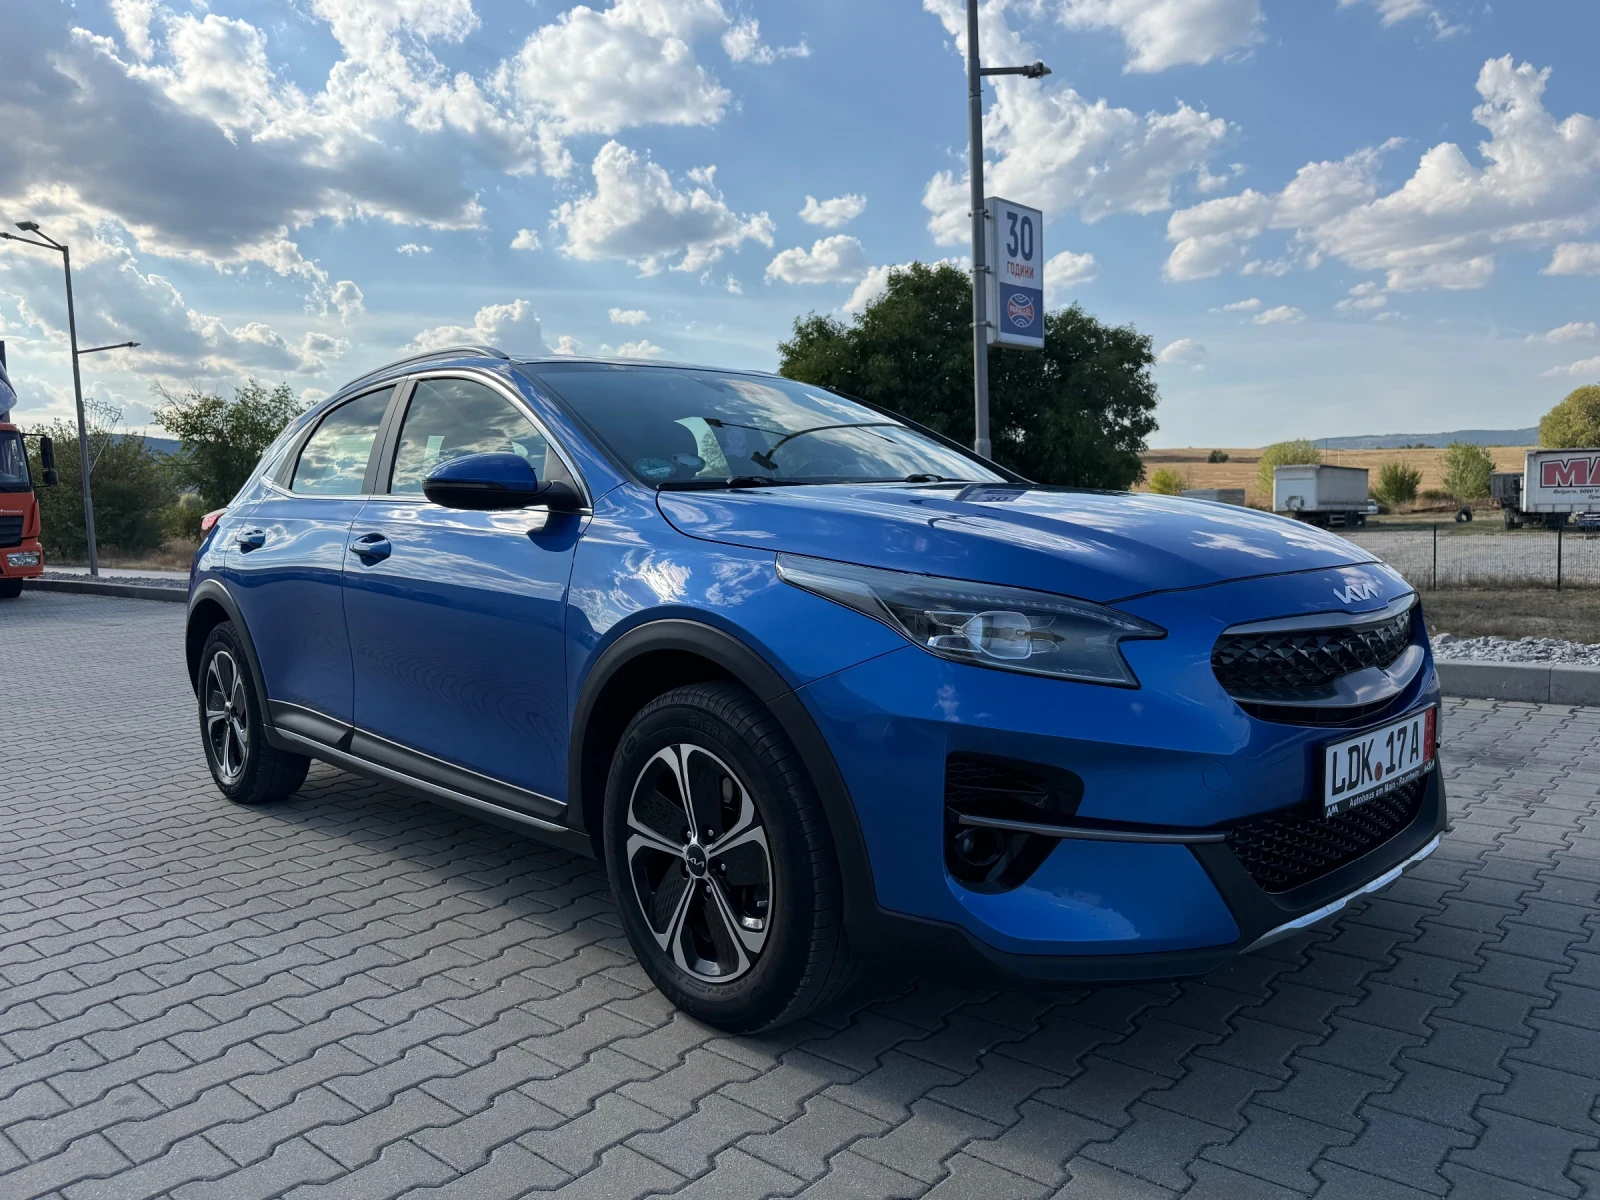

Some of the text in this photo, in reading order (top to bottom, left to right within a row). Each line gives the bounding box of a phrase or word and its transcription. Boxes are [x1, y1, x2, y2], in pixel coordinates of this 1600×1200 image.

[1006, 211, 1034, 261] 30
[1006, 260, 1034, 280] ГОДИНИ
[1331, 738, 1375, 797] LDK
[1385, 720, 1419, 775] 17A
[1349, 770, 1420, 808] Autohaus am Main Raunheim
